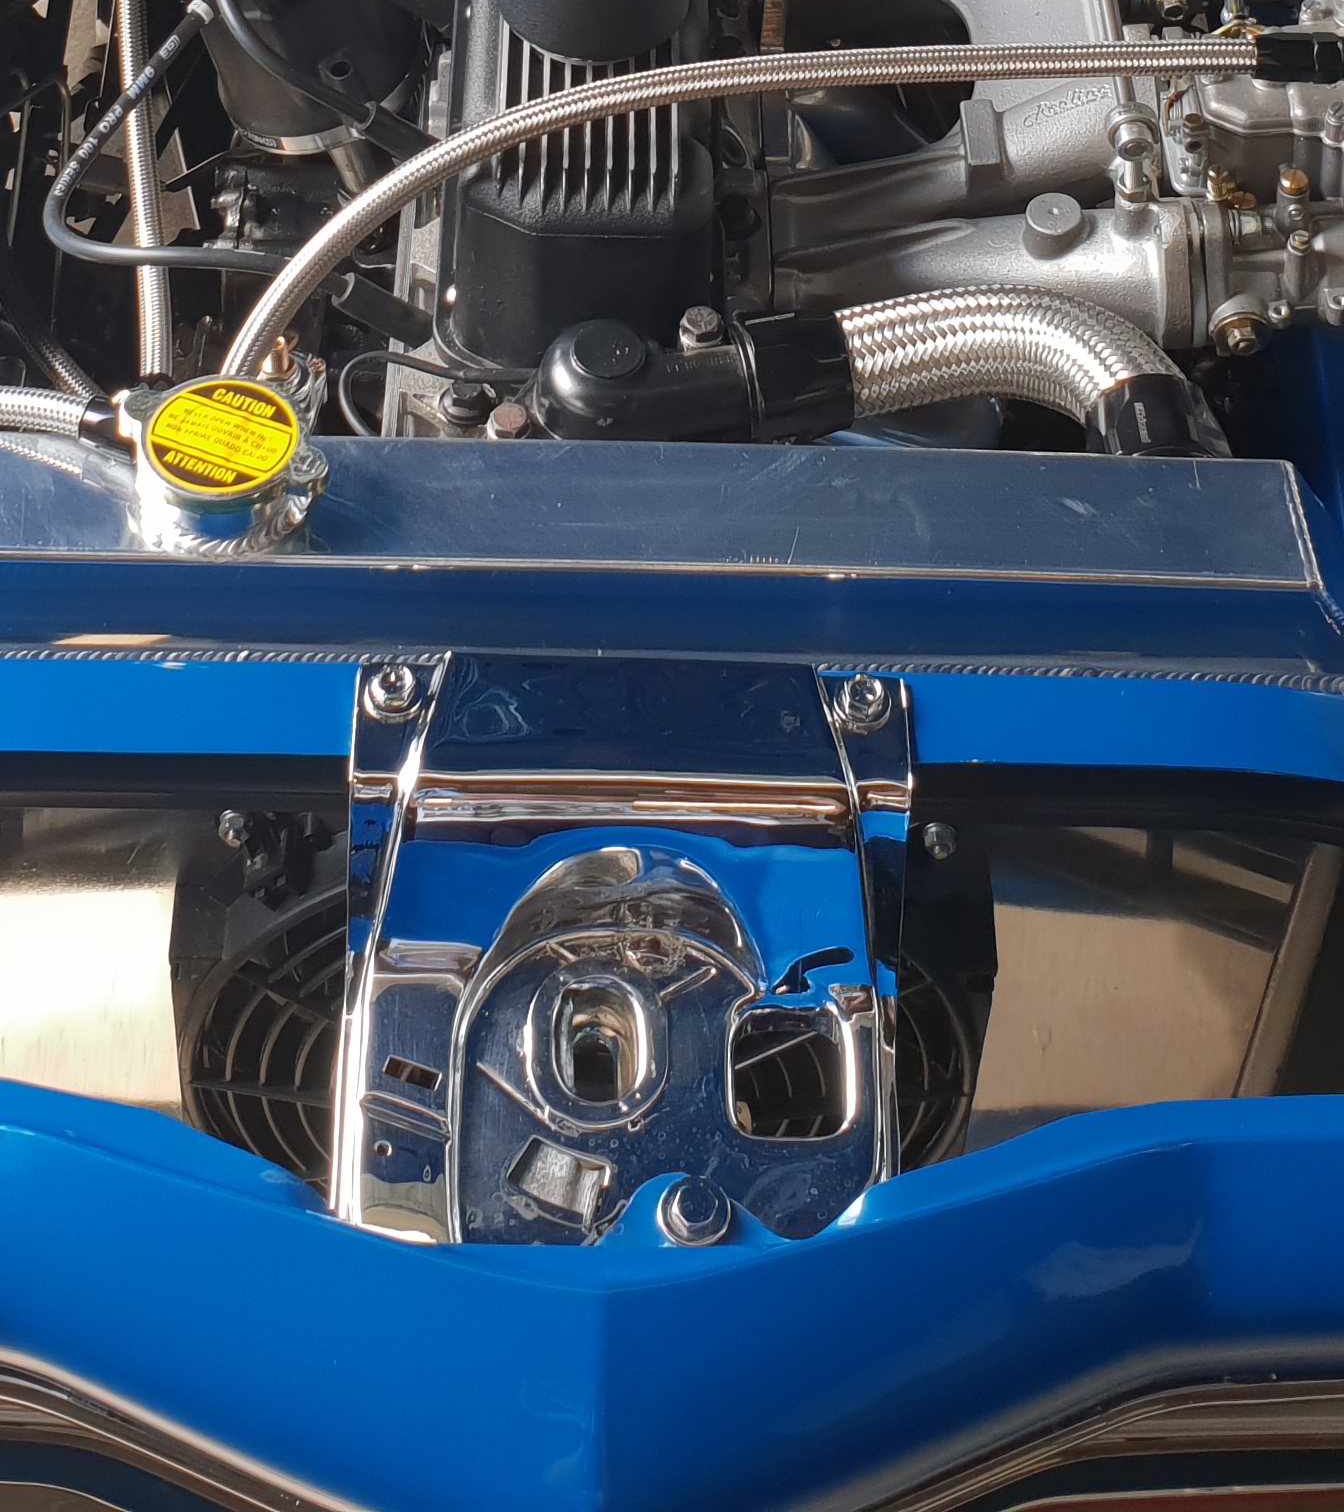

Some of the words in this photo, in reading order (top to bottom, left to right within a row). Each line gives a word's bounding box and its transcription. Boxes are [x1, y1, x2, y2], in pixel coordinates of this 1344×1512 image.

[126, 65, 155, 100] 9MM
[99, 105, 124, 133] PRO
[78, 137, 99, 159] 100
[212, 388, 277, 418] CAUTION
[163, 450, 237, 483] ATTENTION
